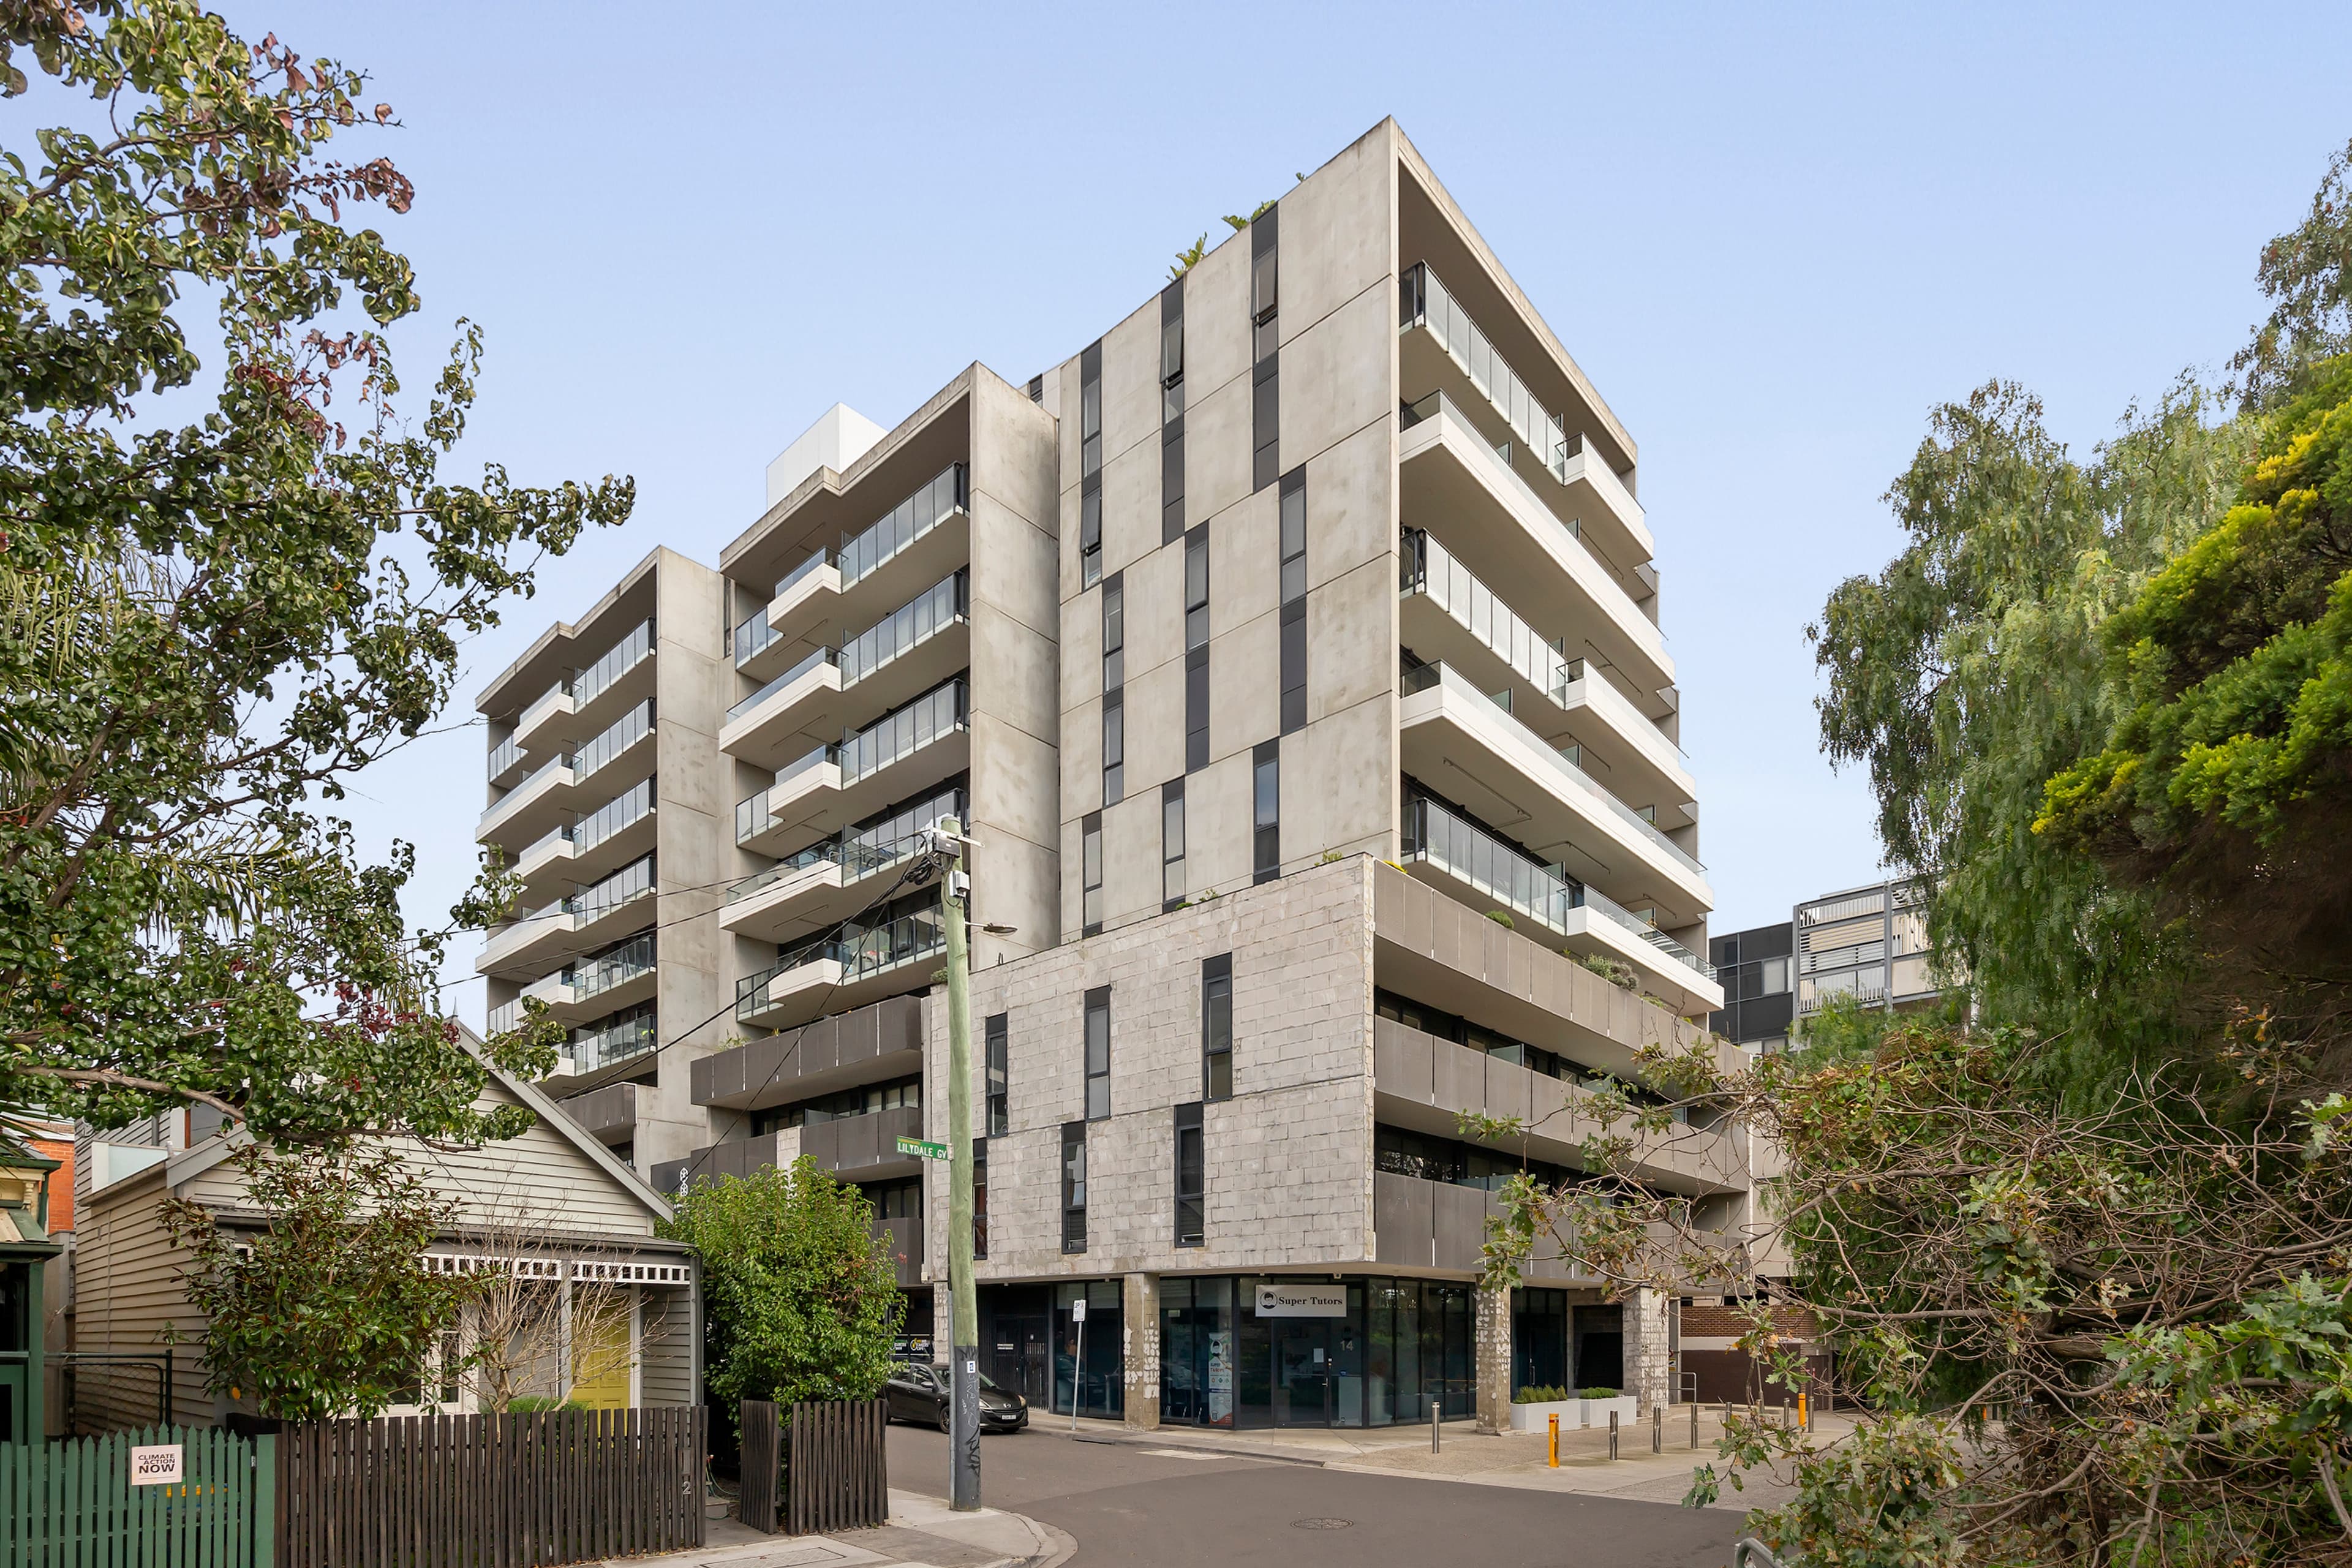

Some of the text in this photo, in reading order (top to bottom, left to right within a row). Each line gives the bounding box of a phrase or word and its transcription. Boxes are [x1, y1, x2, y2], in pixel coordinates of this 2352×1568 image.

[897, 1142, 933, 1157] LILYDALE
[1278, 1297, 1307, 1306] Super
[1340, 1340, 1354, 1351] 14
[139, 1464, 175, 1474] NOW
[683, 1481, 692, 1494] 2
